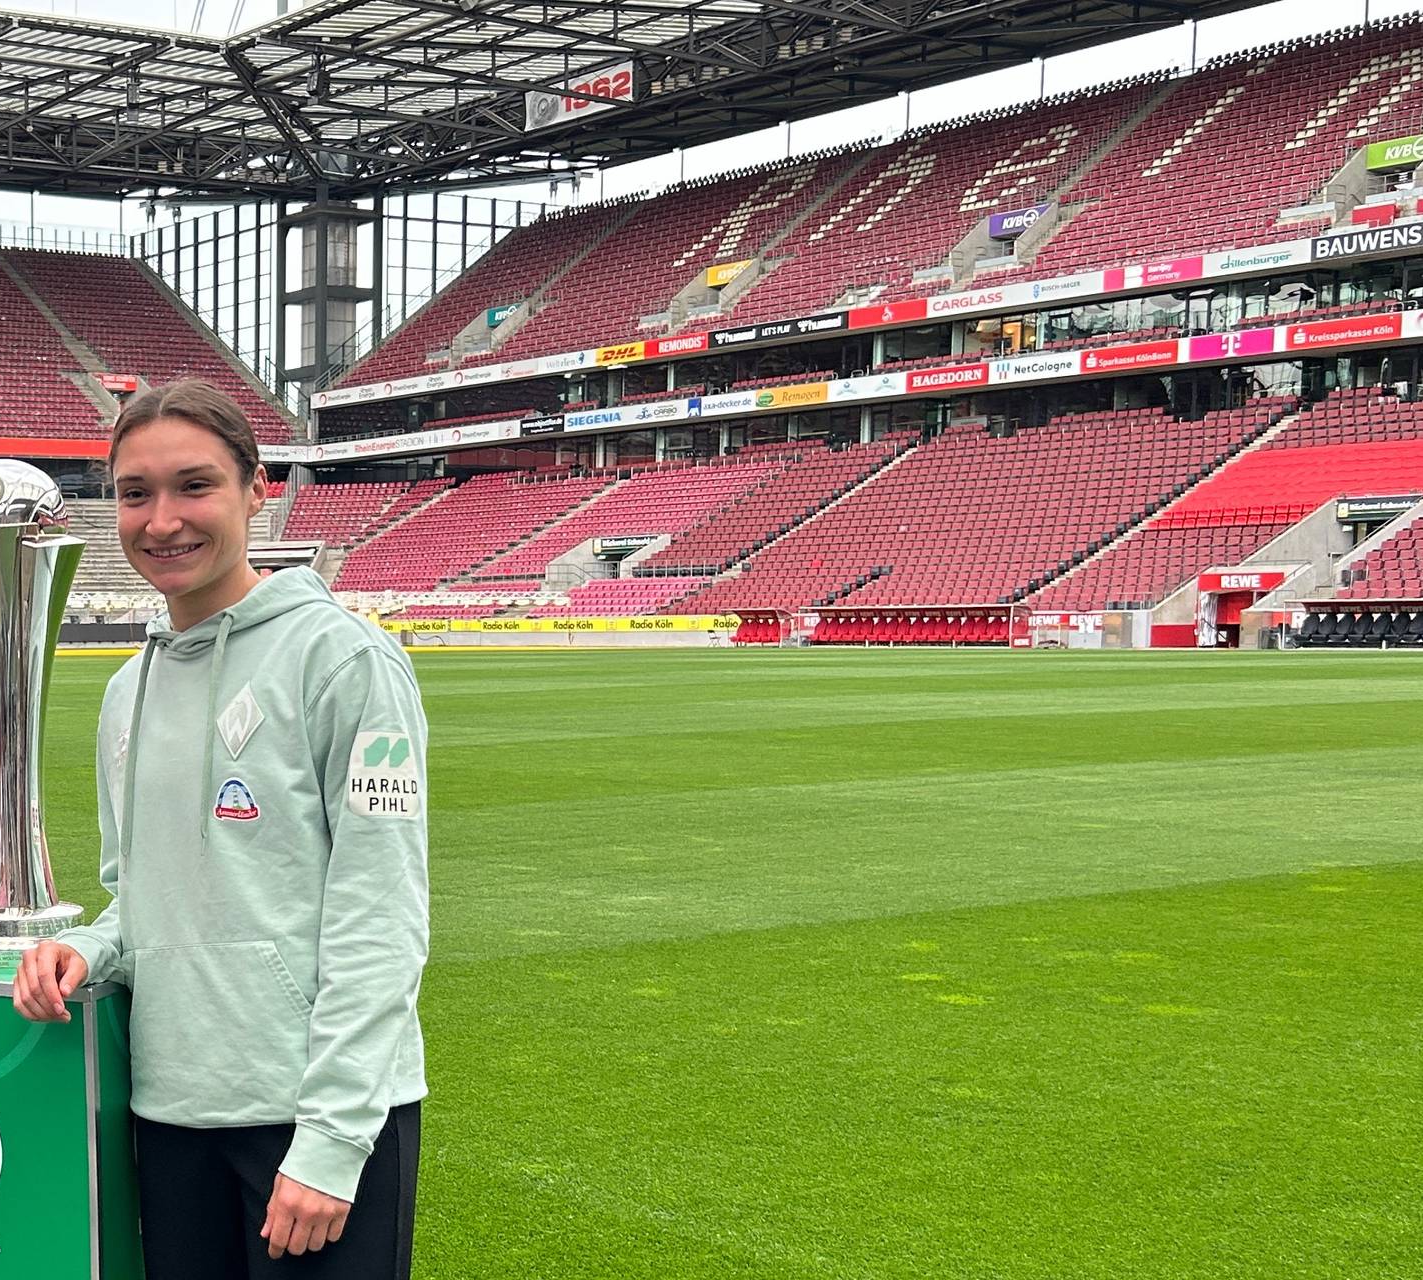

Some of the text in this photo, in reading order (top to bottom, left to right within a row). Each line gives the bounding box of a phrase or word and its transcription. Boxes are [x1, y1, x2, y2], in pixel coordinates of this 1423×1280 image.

[561, 71, 631, 112] 1962
[1385, 144, 1412, 161] KVB
[1002, 216, 1023, 230] KVB
[1316, 225, 1422, 259] BAUWENS
[1221, 253, 1292, 271] dillenburger
[1148, 272, 1181, 282] Germany
[933, 292, 1003, 312] CARGLASS
[762, 325, 791, 337] LET'S PLAY
[1309, 325, 1393, 342] Kreissparkasse Köln
[658, 339, 702, 353] REMONDIS
[602, 347, 637, 361] DHL
[1099, 352, 1172, 367] Sparkasse KölnBonn
[1014, 361, 1073, 376] NetCologne
[912, 369, 982, 387] HAGEDORN
[782, 391, 820, 402] Remagen
[703, 398, 752, 410] axa-decker.de
[567, 412, 621, 427] SIEGENIA
[1221, 575, 1260, 588] REWE
[432, 622, 446, 630] Köln
[483, 622, 519, 630] Radio Köln
[553, 621, 593, 630] Radio Köln
[630, 619, 673, 629] Radio Köln
[714, 619, 738, 628] Radio
[1029, 616, 1060, 627] REWE
[1070, 615, 1103, 626] REWE
[352, 778, 417, 794] HARALD
[369, 797, 407, 812] PIHL
